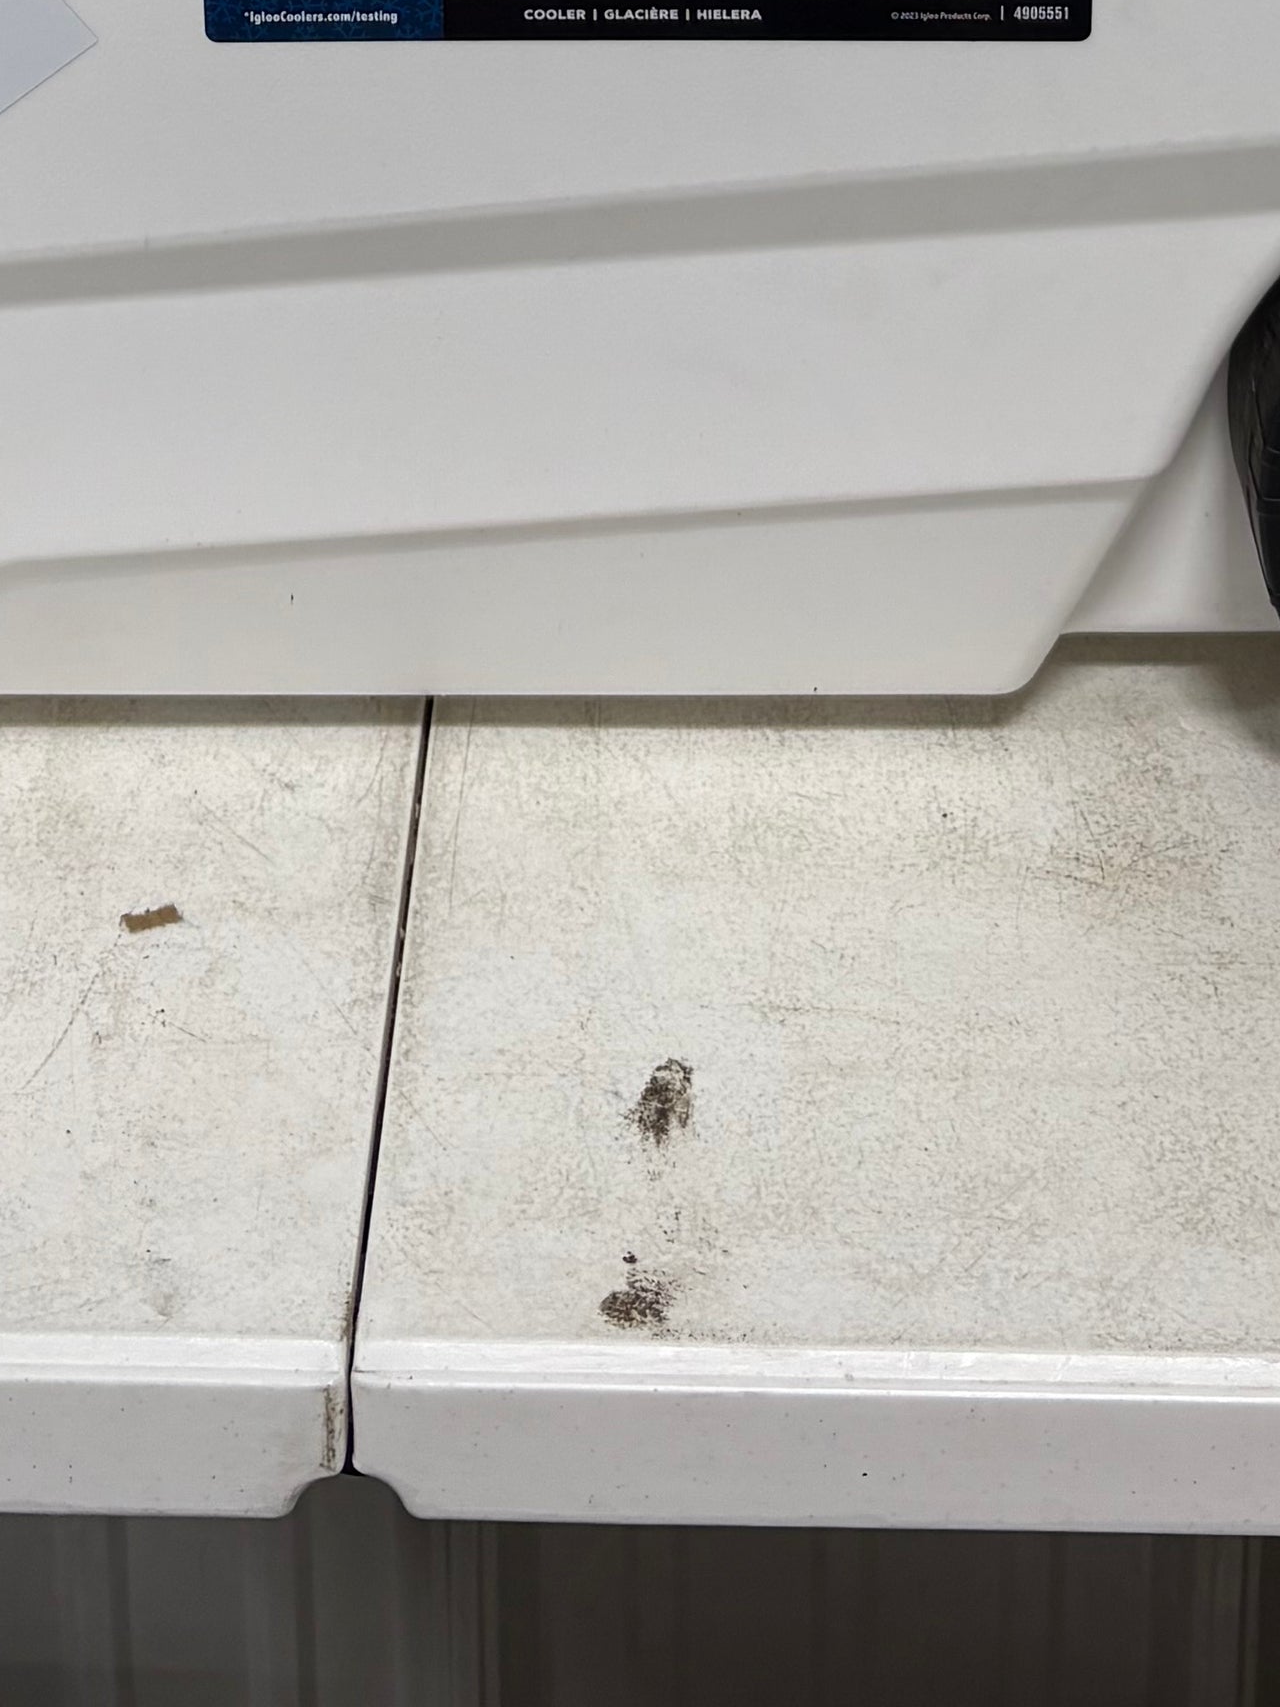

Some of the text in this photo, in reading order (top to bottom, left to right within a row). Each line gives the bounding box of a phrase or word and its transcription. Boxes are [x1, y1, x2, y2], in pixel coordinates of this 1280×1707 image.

[524, 9, 586, 20] COOLER
[604, 7, 679, 20] GLACIÈRE
[697, 9, 762, 20] HIELERA
